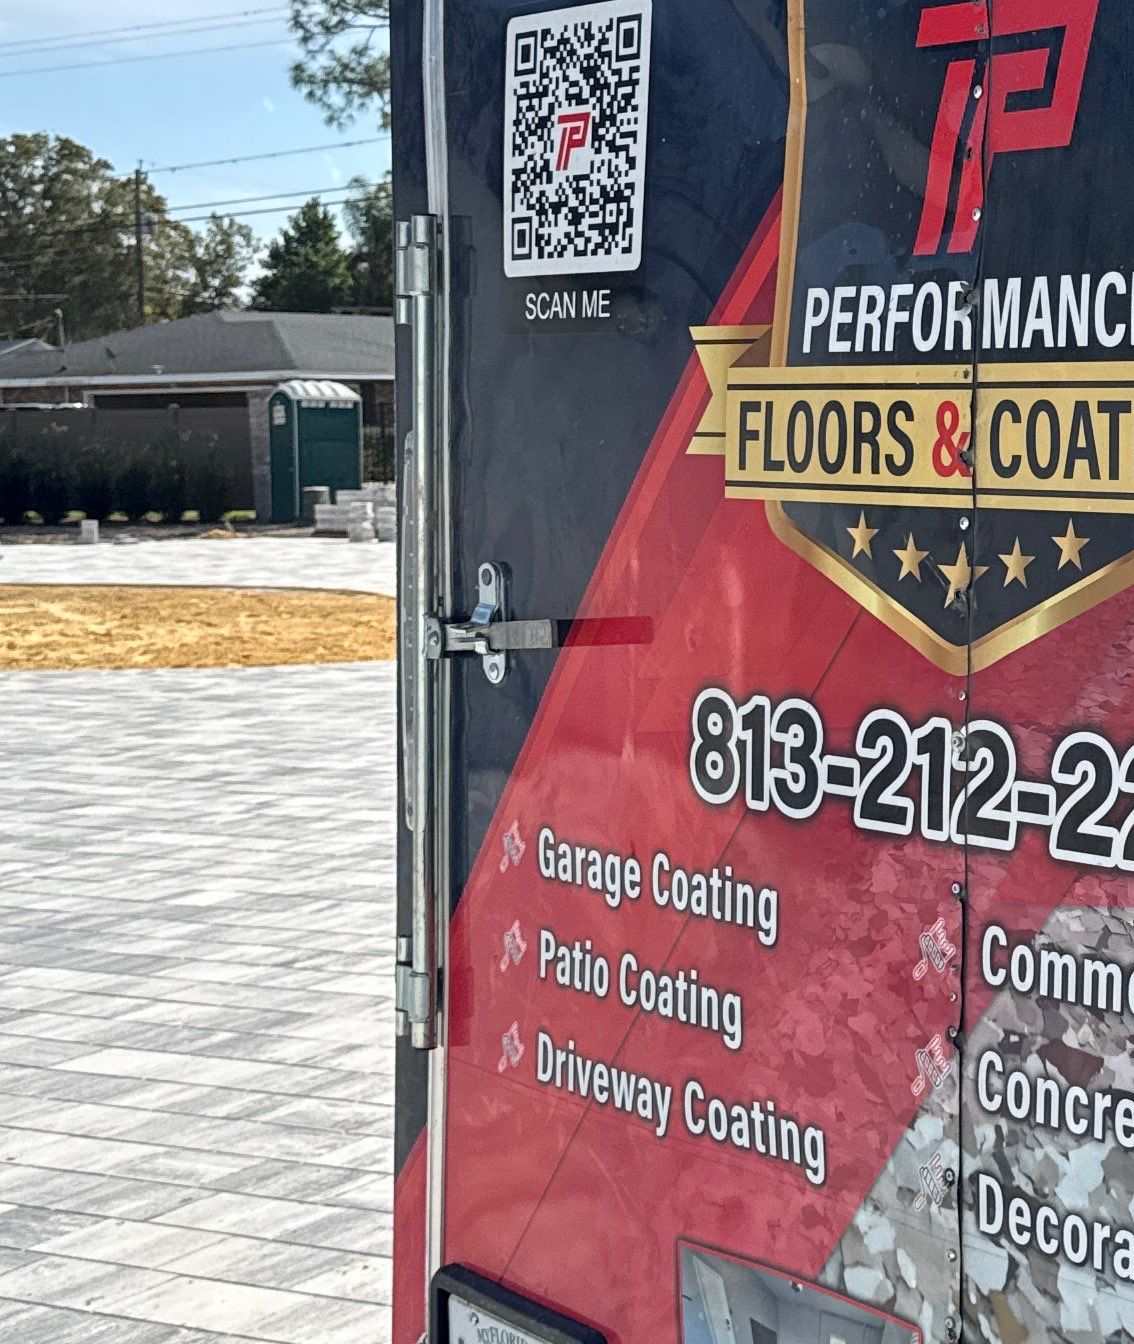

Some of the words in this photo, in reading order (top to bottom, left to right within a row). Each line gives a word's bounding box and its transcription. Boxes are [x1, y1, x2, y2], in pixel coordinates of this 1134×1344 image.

[525, 290, 577, 320] SCAN
[582, 289, 611, 318] ME
[736, 398, 915, 478] FLOORS
[931, 400, 973, 479] &
[537, 827, 642, 907] Garage
[651, 852, 778, 946] Coating
[539, 929, 609, 998] Patio
[618, 952, 743, 1050] Coating
[536, 1031, 673, 1137] Driveway
[683, 1080, 826, 1185] Coating
